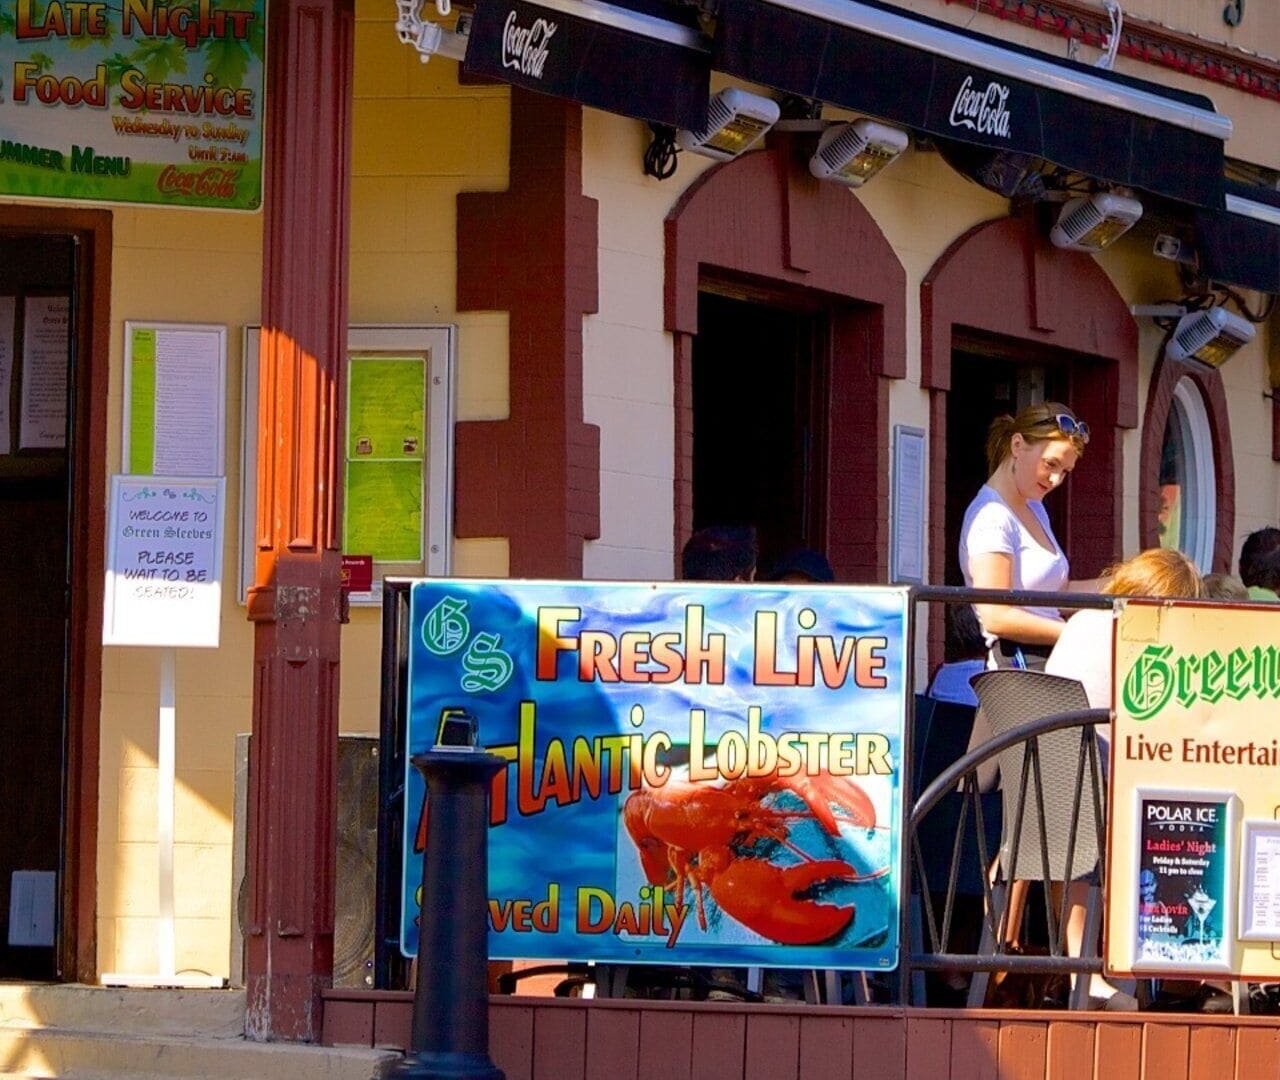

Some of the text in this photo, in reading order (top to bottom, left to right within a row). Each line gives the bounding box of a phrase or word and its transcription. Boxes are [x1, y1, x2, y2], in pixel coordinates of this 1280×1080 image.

[502, 10, 558, 80] Coca-Cola
[949, 76, 1011, 139] Coca-Cola
[129, 510, 208, 522] WELCOME TO
[123, 525, 212, 539] Green Sleeves
[138, 550, 194, 565] PLEASE
[124, 568, 207, 582] WAIT TO BE
[1125, 734, 1173, 762] Live
[1147, 805, 1218, 822] POLAR ICE
[1147, 840, 1216, 856] Ladies' Night
[1153, 856, 1210, 868] Friday & Saturday
